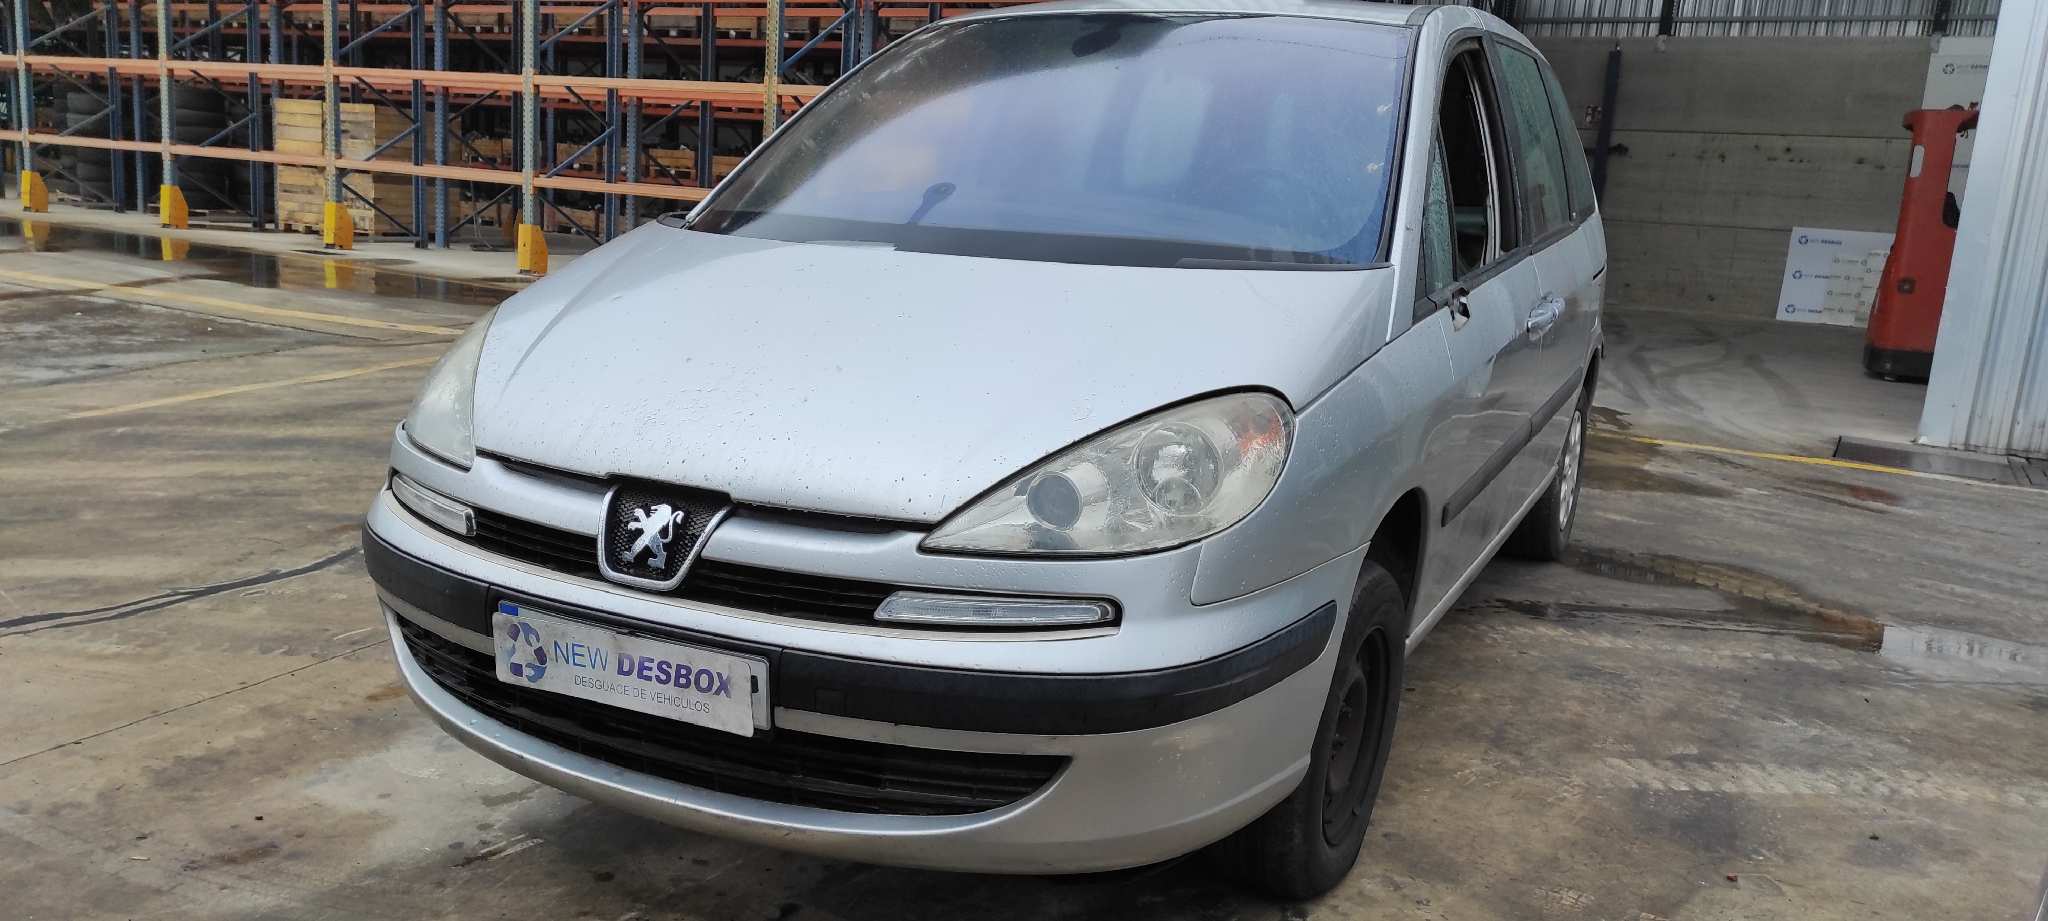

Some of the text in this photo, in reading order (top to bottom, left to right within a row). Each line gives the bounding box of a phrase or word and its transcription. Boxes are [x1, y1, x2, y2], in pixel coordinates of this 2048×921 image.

[554, 640, 731, 699] NEW DESBOX
[574, 674, 629, 696] DESGUACE
[633, 686, 648, 698] DE
